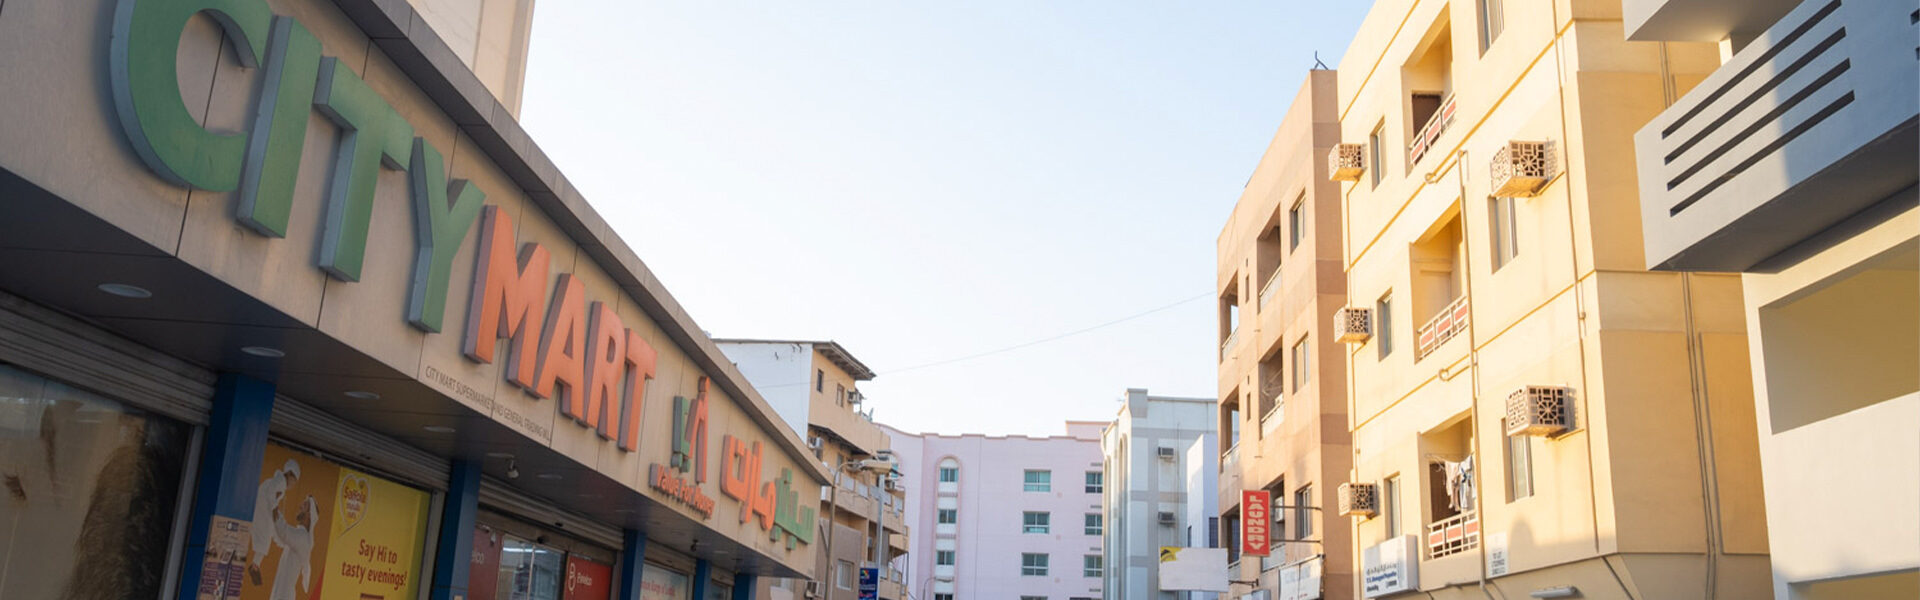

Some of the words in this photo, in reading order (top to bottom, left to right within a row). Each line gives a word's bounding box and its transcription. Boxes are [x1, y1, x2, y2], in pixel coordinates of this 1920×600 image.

[111, 0, 486, 333] CITY
[464, 205, 657, 452] MART
[425, 365, 440, 380] CITY
[440, 373, 456, 391] MART
[650, 463, 680, 496] Value
[720, 434, 776, 531] مارت
[1248, 495, 1265, 550] LAUNDRY
[358, 539, 376, 562] Say
[377, 545, 387, 564] Hi
[388, 550, 397, 564] to
[341, 561, 365, 584] tasty
[367, 567, 408, 591] evenings!
